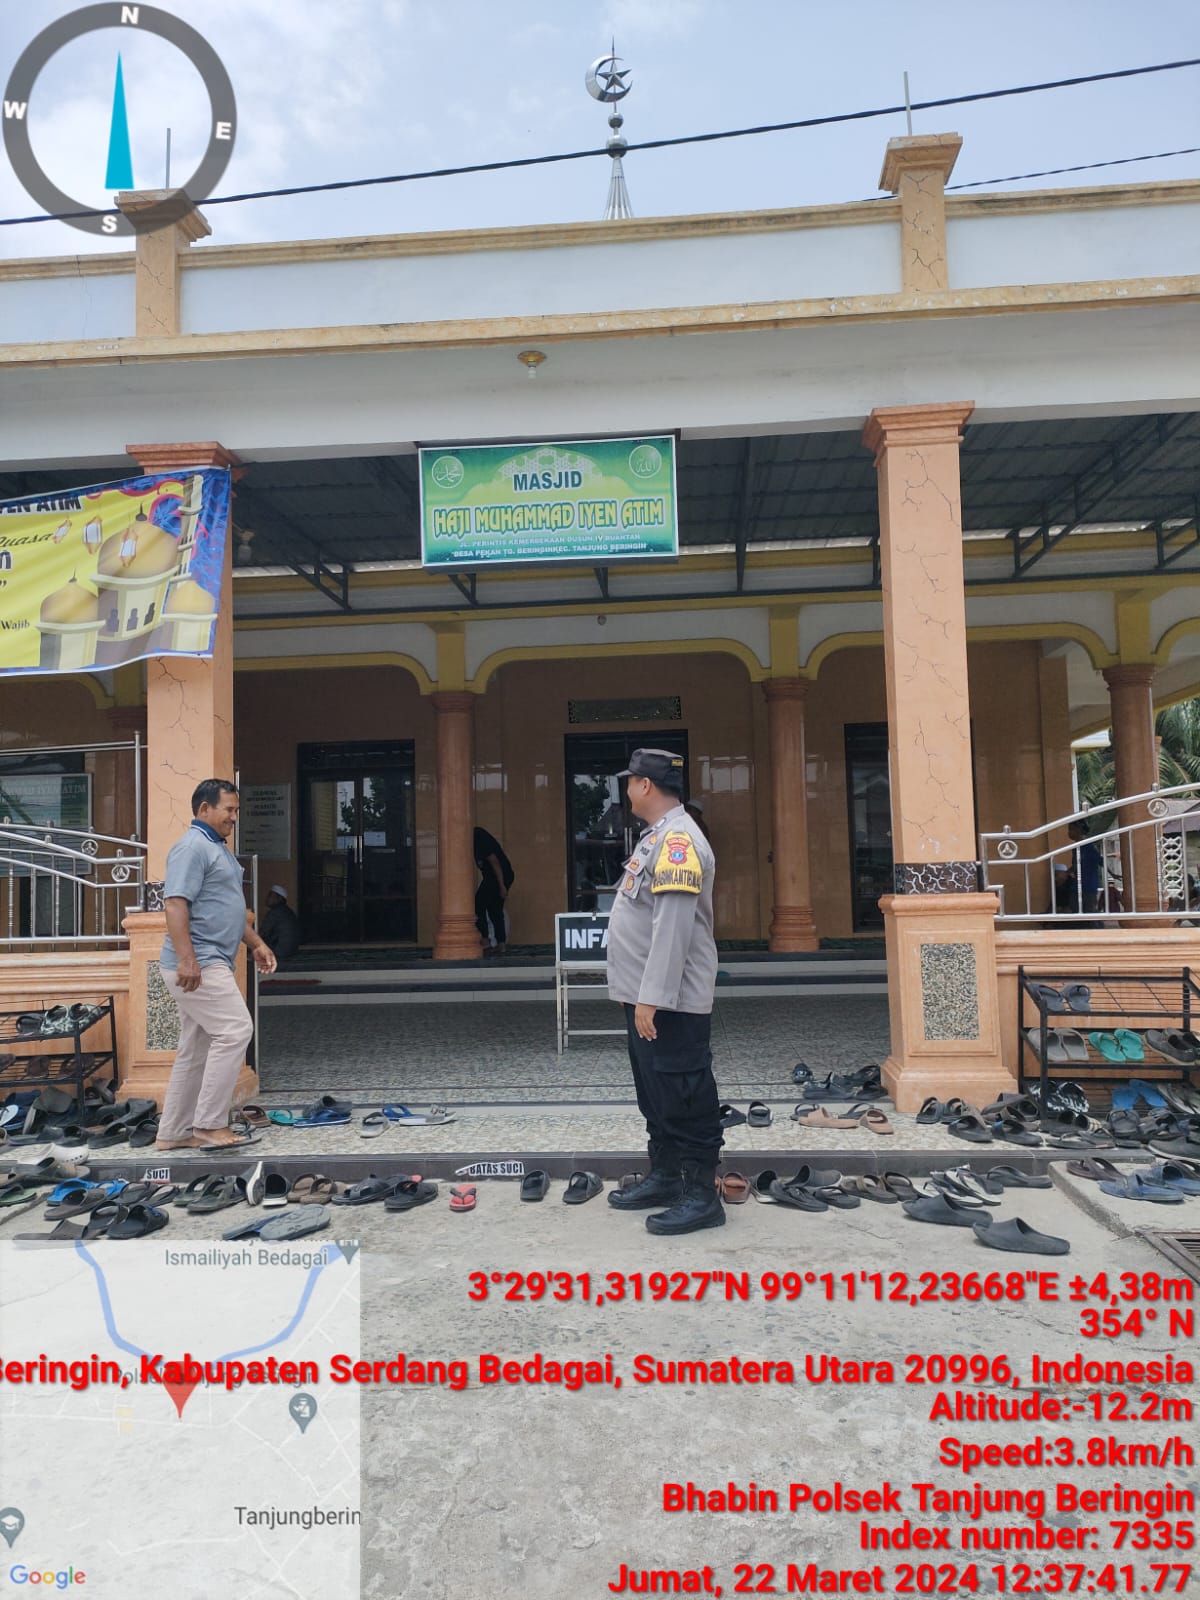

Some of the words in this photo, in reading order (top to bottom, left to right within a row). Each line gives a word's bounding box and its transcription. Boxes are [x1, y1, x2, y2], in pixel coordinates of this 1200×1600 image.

[513, 470, 582, 491] MASJID
[434, 507, 471, 539] HAJI
[475, 503, 575, 534] MUHAMMAD
[578, 500, 617, 530] IYEN
[621, 498, 664, 529] ATIM
[573, 543, 608, 552] TANJUNG
[1, 618, 31, 631] Wajib
[146, 1168, 169, 1180] SUCI
[470, 1163, 498, 1175] BATAS
[500, 1162, 523, 1174] SUCI
